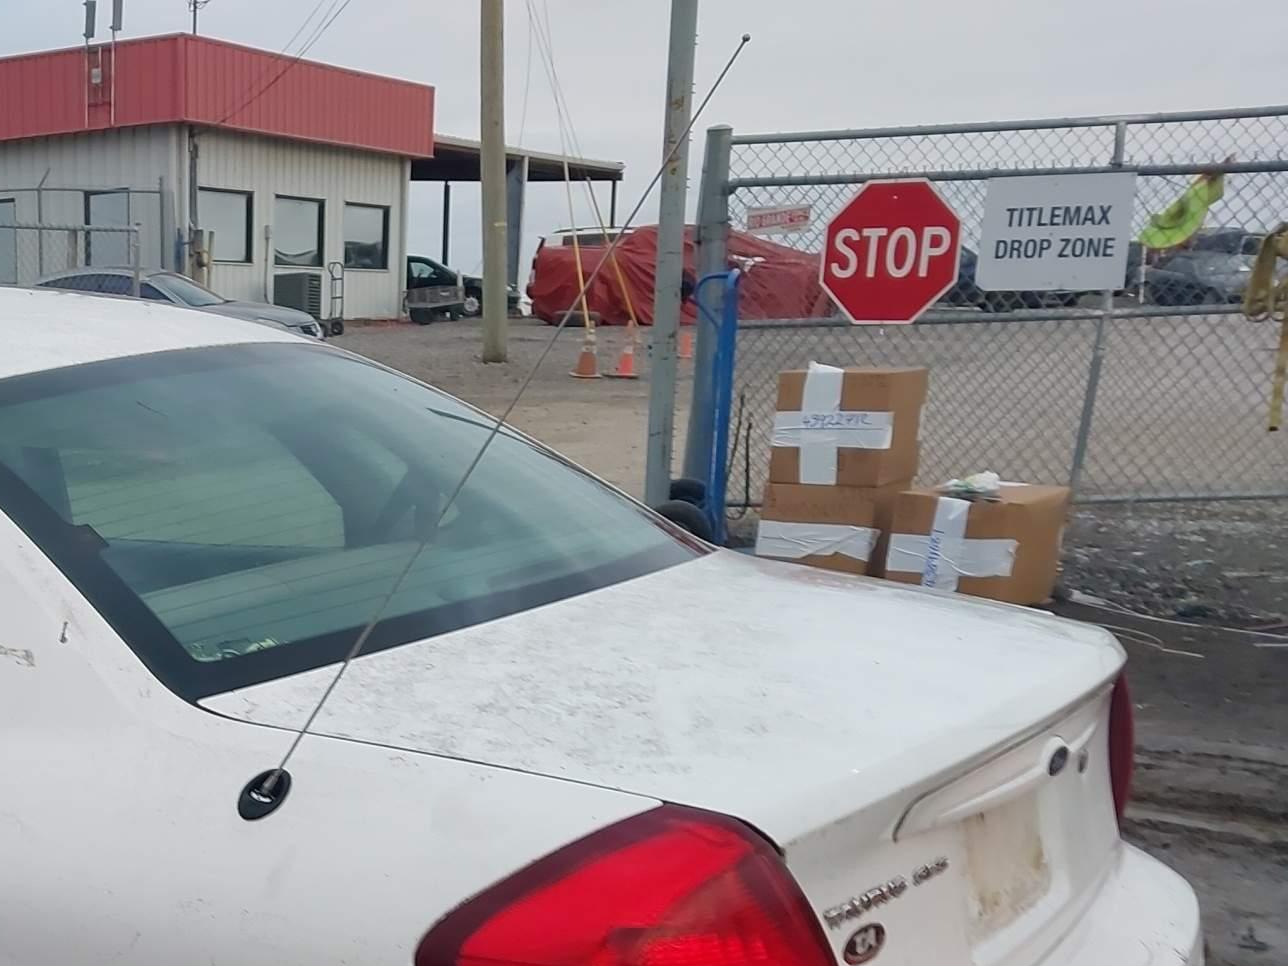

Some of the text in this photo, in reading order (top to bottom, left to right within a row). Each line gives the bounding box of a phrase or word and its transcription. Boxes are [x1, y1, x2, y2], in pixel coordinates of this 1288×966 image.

[1006, 205, 1112, 227] TITLEMAX
[830, 226, 951, 278] STOP
[994, 237, 1116, 259] DROP ZONE
